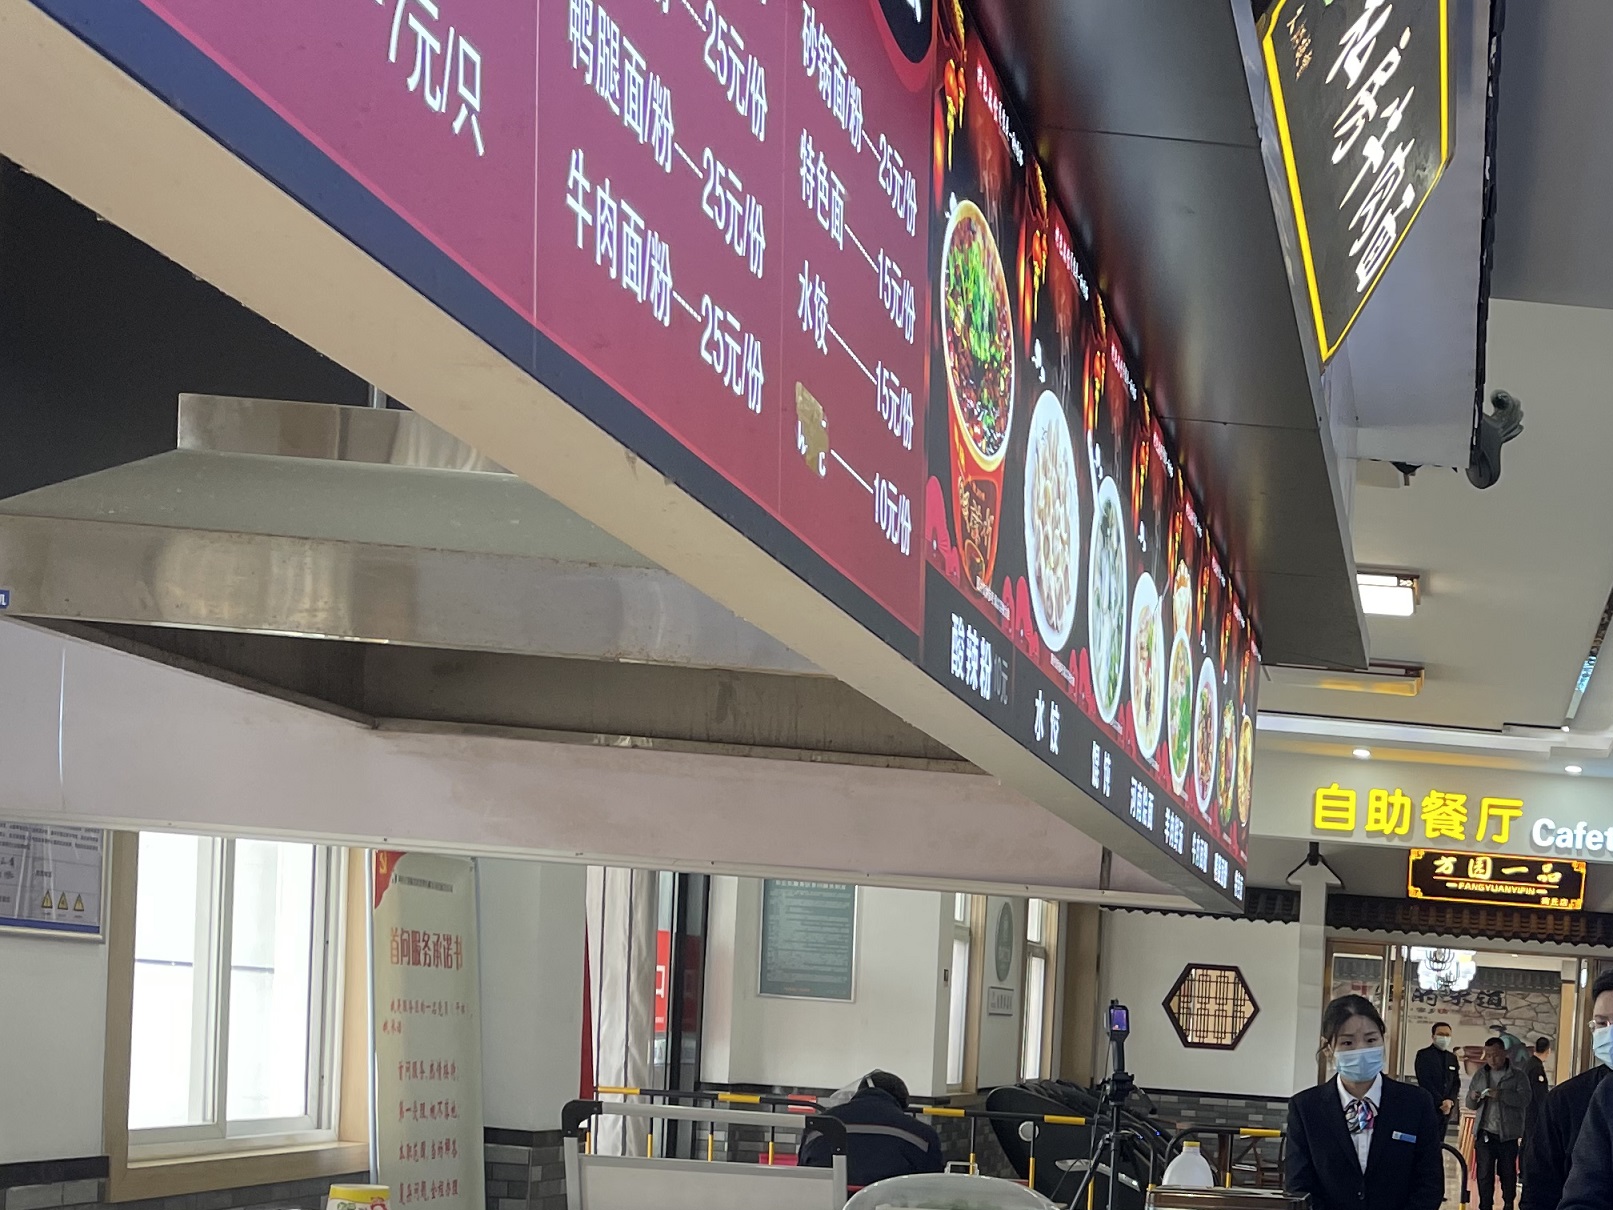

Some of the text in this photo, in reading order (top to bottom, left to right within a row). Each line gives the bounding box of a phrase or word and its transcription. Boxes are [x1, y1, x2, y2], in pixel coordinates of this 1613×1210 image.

[702, 147, 767, 279] 25元/份
[800, 128, 916, 344] 特色面 15元/份
[878, 133, 918, 237] 25元/份
[566, 148, 765, 414] 牛肉面/粉 25元/份
[798, 260, 914, 451] 水饺 15元/份
[873, 472, 912, 556] 10元/份
[951, 612, 992, 700] 酸辣粉
[1313, 782, 1524, 845] 自助餐厅
[390, 926, 464, 971] 首问服务承诺书
